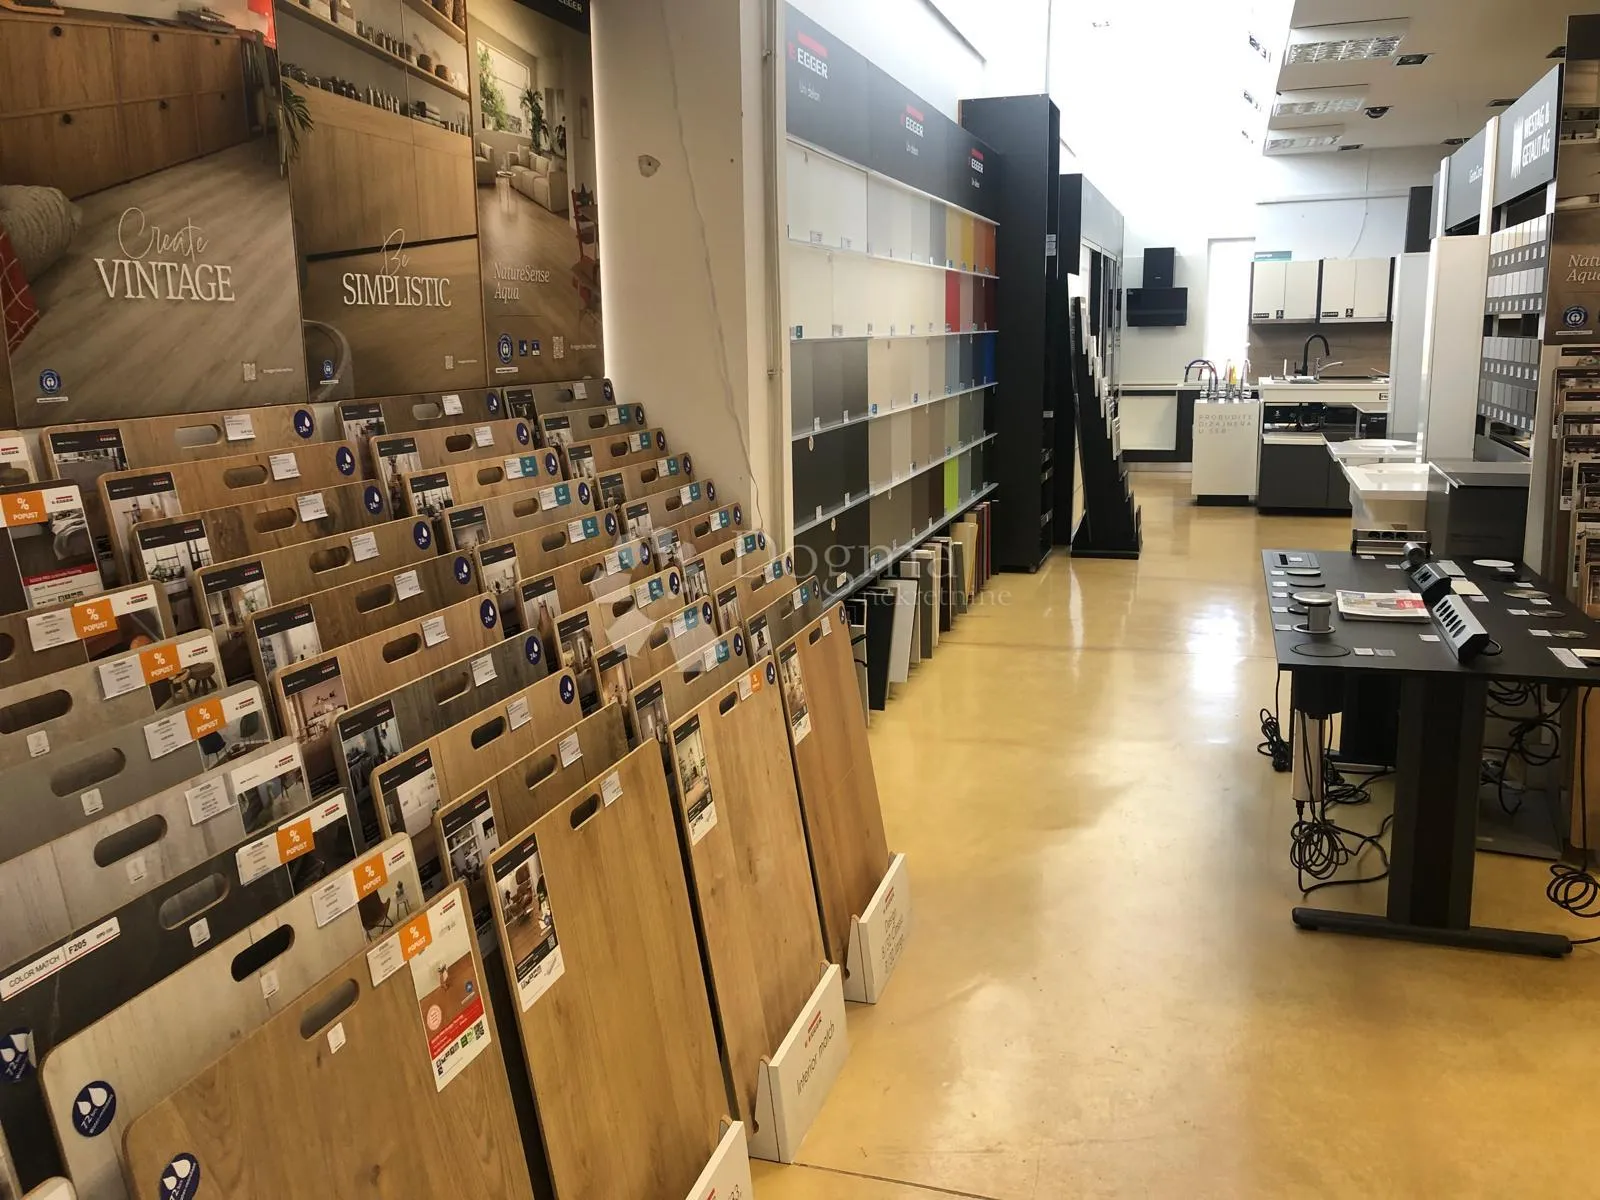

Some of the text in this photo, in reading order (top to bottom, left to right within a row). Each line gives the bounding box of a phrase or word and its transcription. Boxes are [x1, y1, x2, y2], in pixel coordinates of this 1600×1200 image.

[797, 47, 828, 80] EGGER
[905, 116, 924, 138] EGGER
[118, 207, 209, 262] Create
[380, 228, 411, 277] Be
[94, 258, 235, 301] VINTAGE
[494, 262, 550, 283] NatureSense
[342, 272, 452, 307] SIMPLISTIC
[494, 282, 520, 304] Aqua
[13, 512, 38, 520] POPUST
[83, 621, 108, 632] POPUST
[151, 664, 174, 678] POPUST
[197, 719, 219, 733] POPUST
[286, 841, 308, 856] POPUST
[363, 875, 381, 891] POPUST
[9, 939, 87, 988] COLOR MATCH F205
[797, 1019, 834, 1096] Interior match
[81, 1115, 93, 1130] 72
